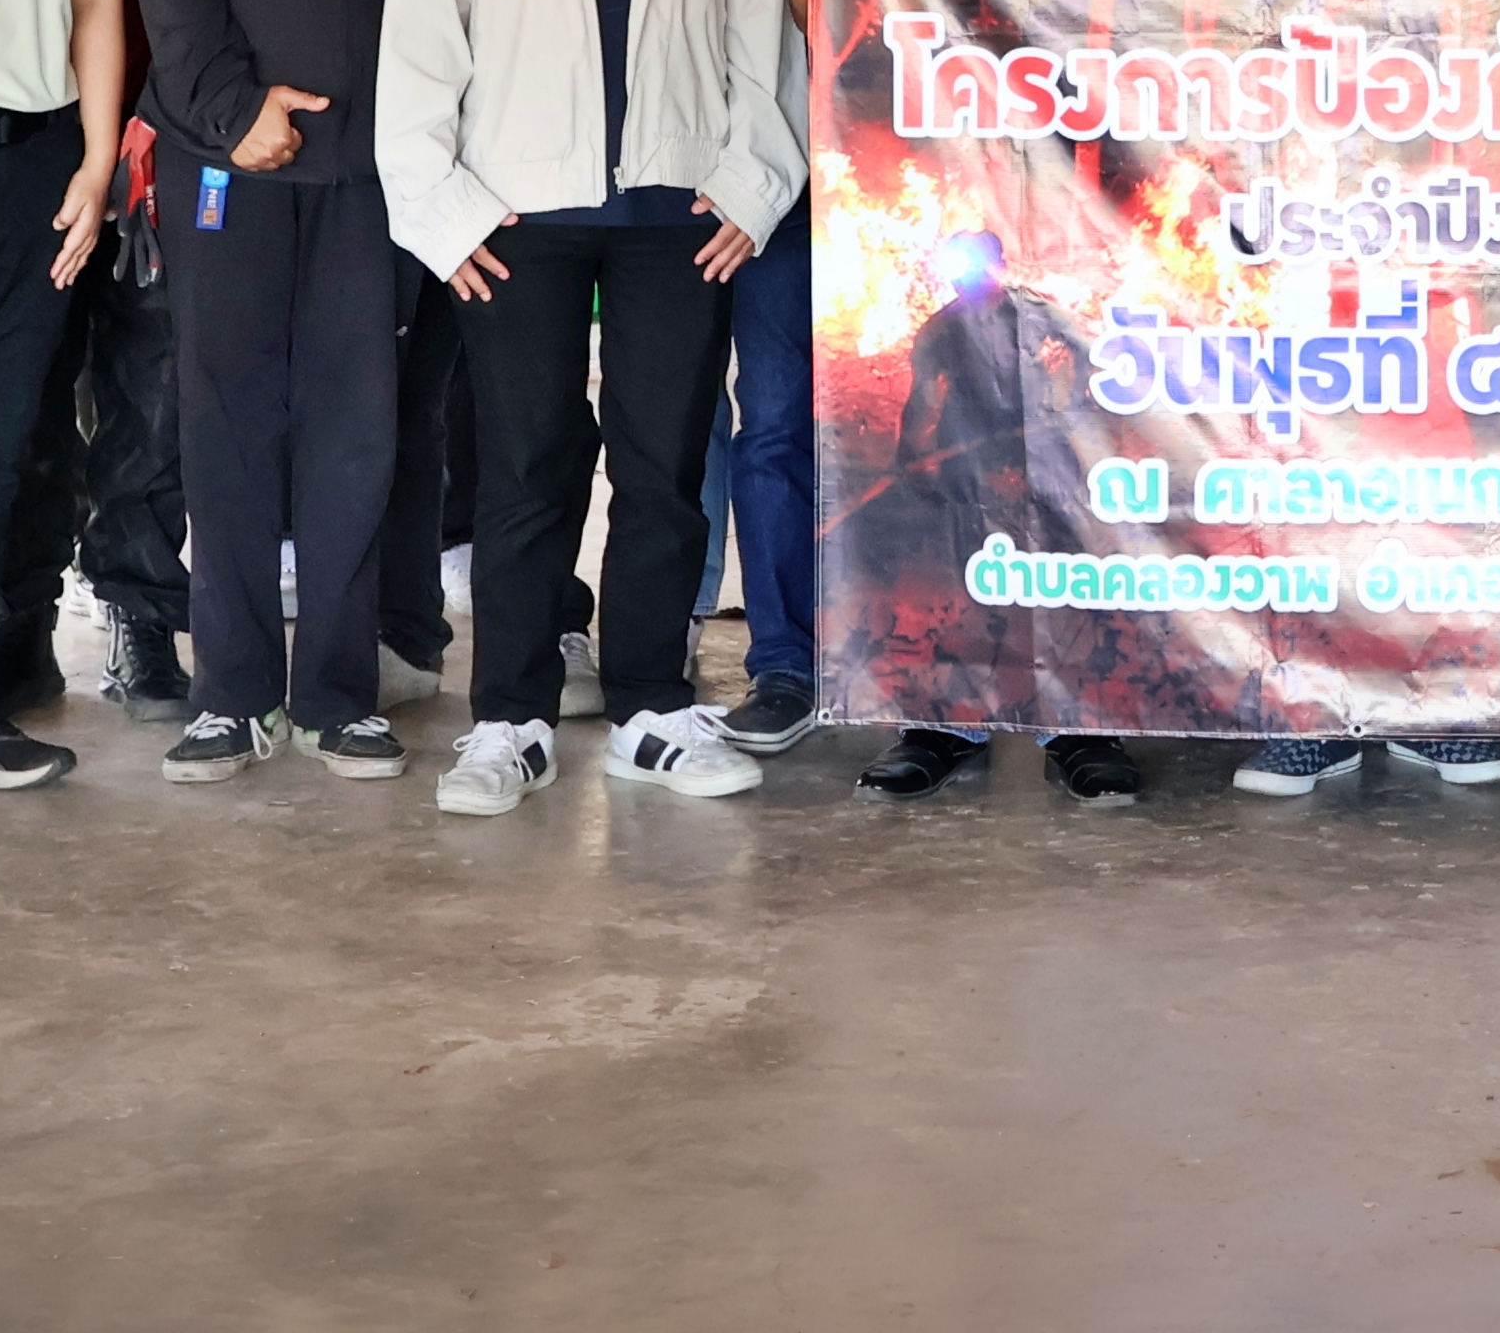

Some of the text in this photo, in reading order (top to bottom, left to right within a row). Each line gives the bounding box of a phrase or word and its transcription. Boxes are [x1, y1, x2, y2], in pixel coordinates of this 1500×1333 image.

[1092, 277, 1419, 434] วันพุธที่
[1095, 465, 1161, 516] ณ
[974, 541, 1333, 603] ตำบลคลองวาฬ
